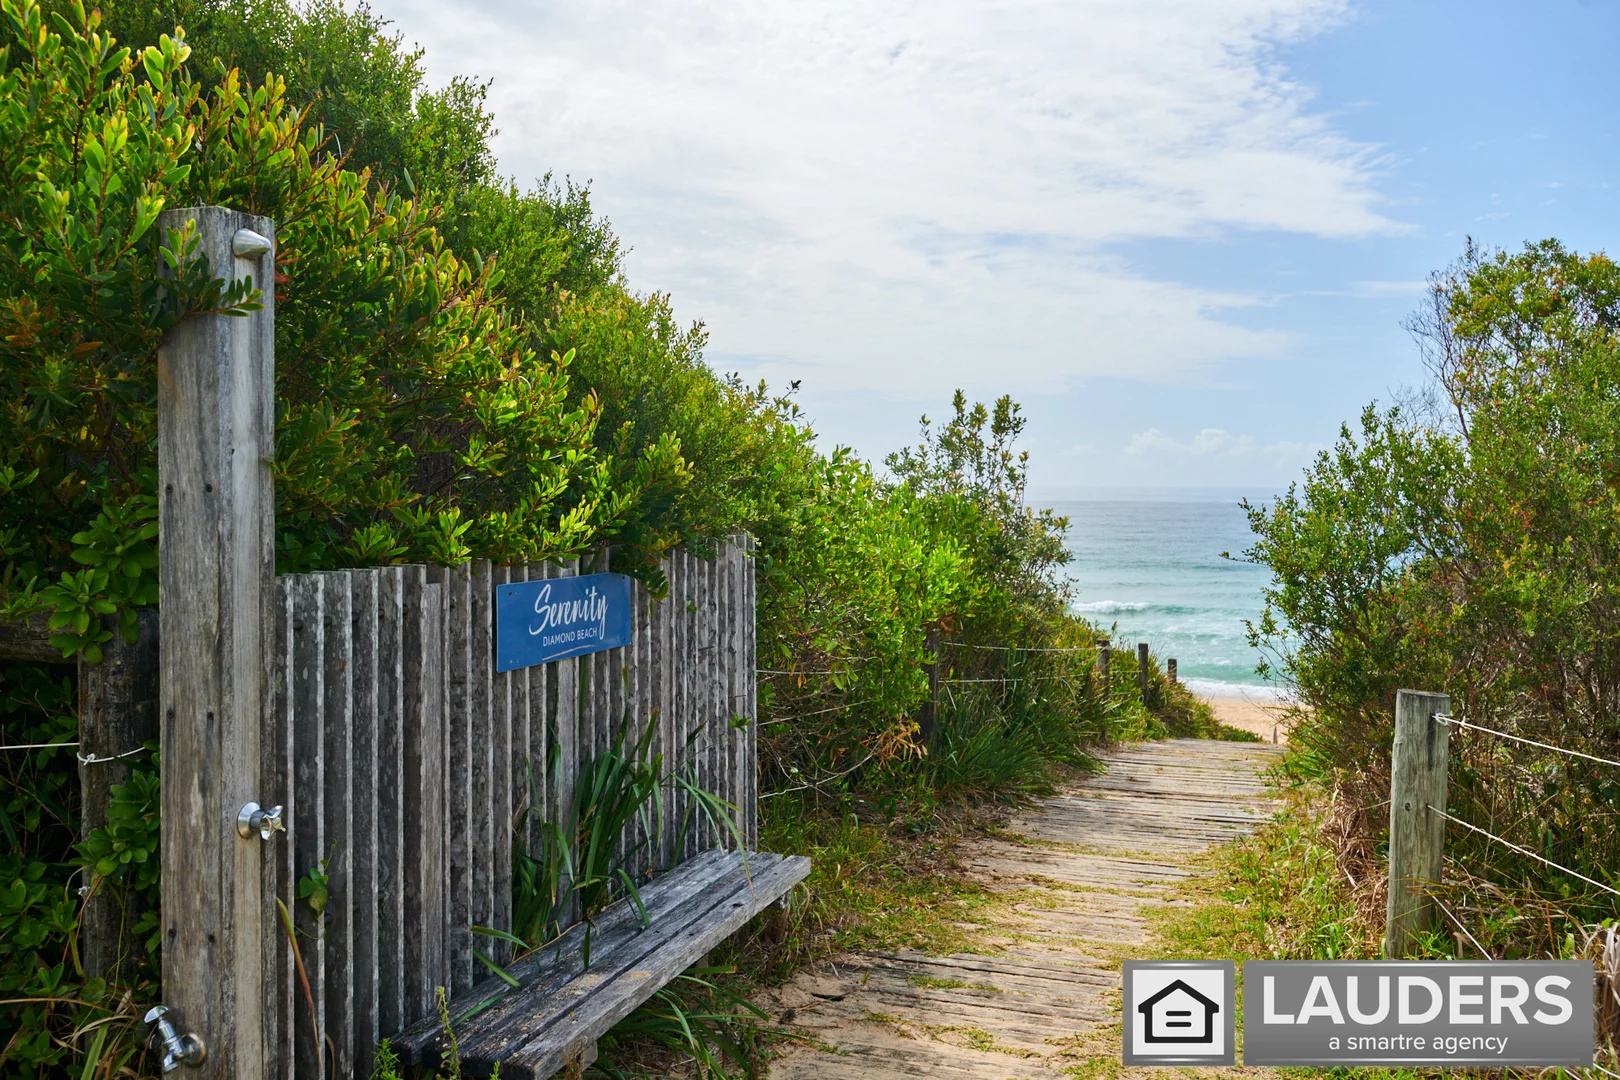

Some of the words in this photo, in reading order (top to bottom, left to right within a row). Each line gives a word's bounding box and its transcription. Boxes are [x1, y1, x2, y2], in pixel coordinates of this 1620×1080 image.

[528, 583, 609, 640] Serenity
[543, 631, 576, 647] DIAMOND
[577, 627, 598, 639] BEACH
